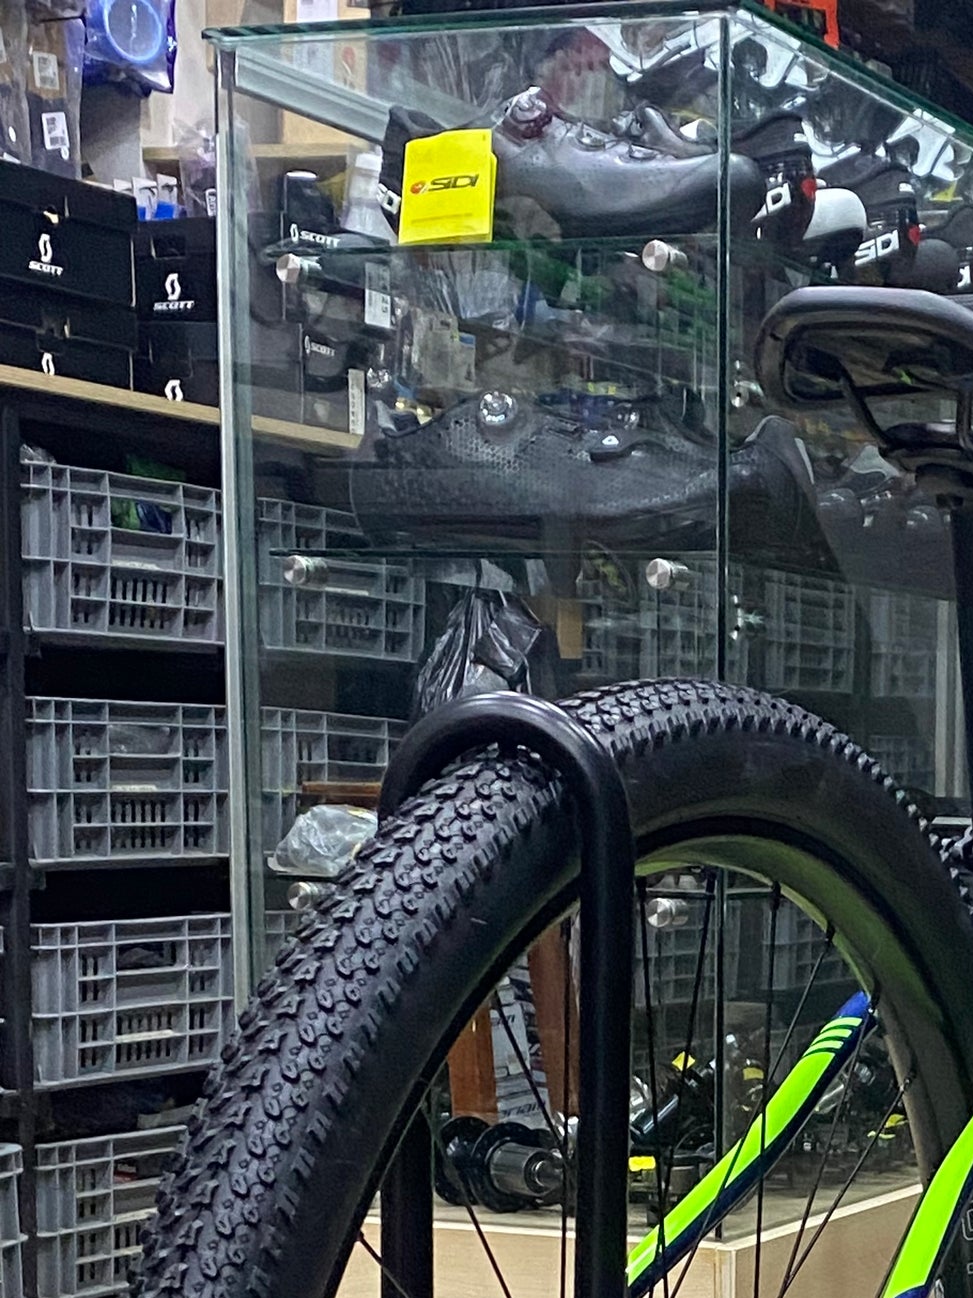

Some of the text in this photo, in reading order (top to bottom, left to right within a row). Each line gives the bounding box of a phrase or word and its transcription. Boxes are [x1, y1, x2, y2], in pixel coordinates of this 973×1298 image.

[299, 230, 341, 249] SCOTT
[28, 260, 64, 276] SCOTT
[153, 300, 195, 312] SCOTT
[310, 341, 336, 357] SCOTT
